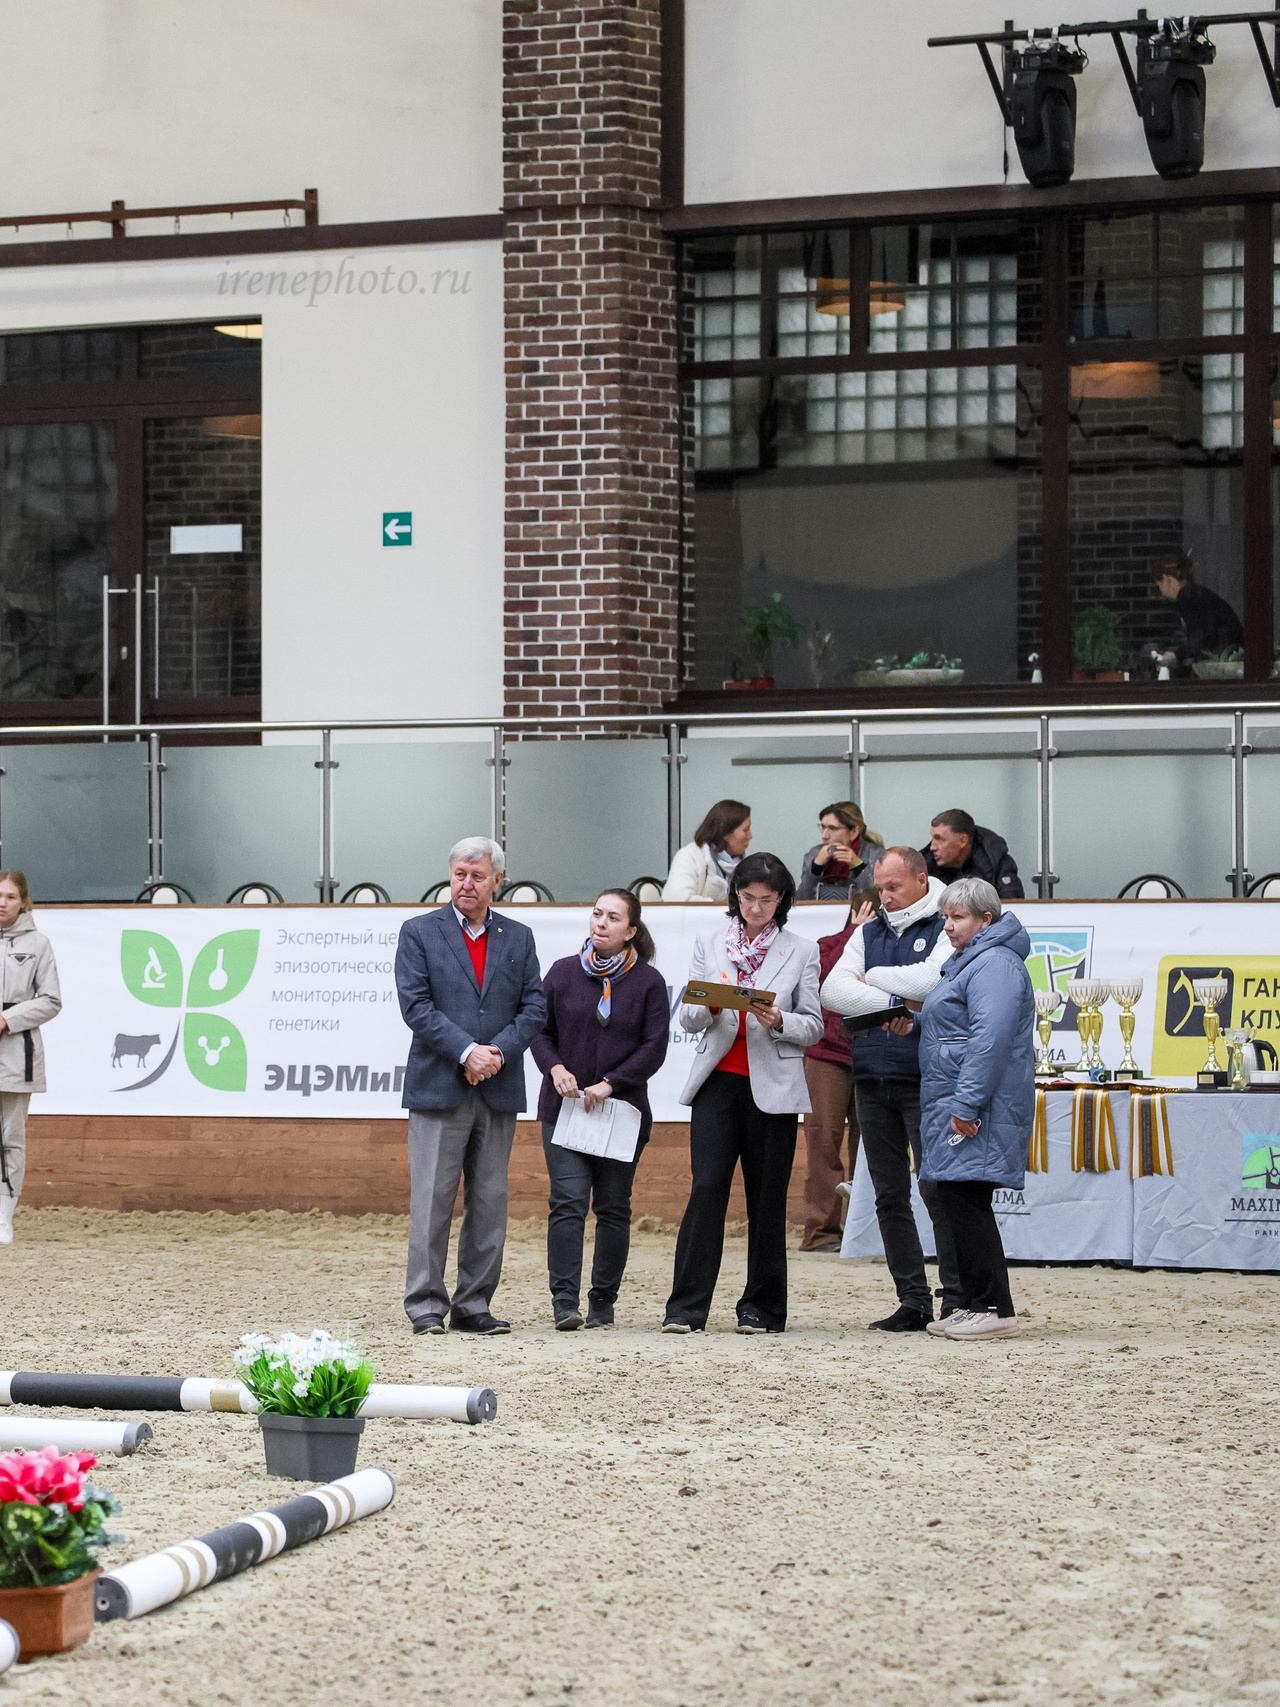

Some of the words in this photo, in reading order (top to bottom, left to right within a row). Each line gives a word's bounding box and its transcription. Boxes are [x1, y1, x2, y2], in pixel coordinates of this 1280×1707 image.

[276, 928, 374, 949] Экспертный
[271, 990, 378, 1006] мониторинга
[383, 991, 393, 1003] и
[269, 1018, 340, 1031] генетики
[1231, 1198, 1280, 1212] MAXI
